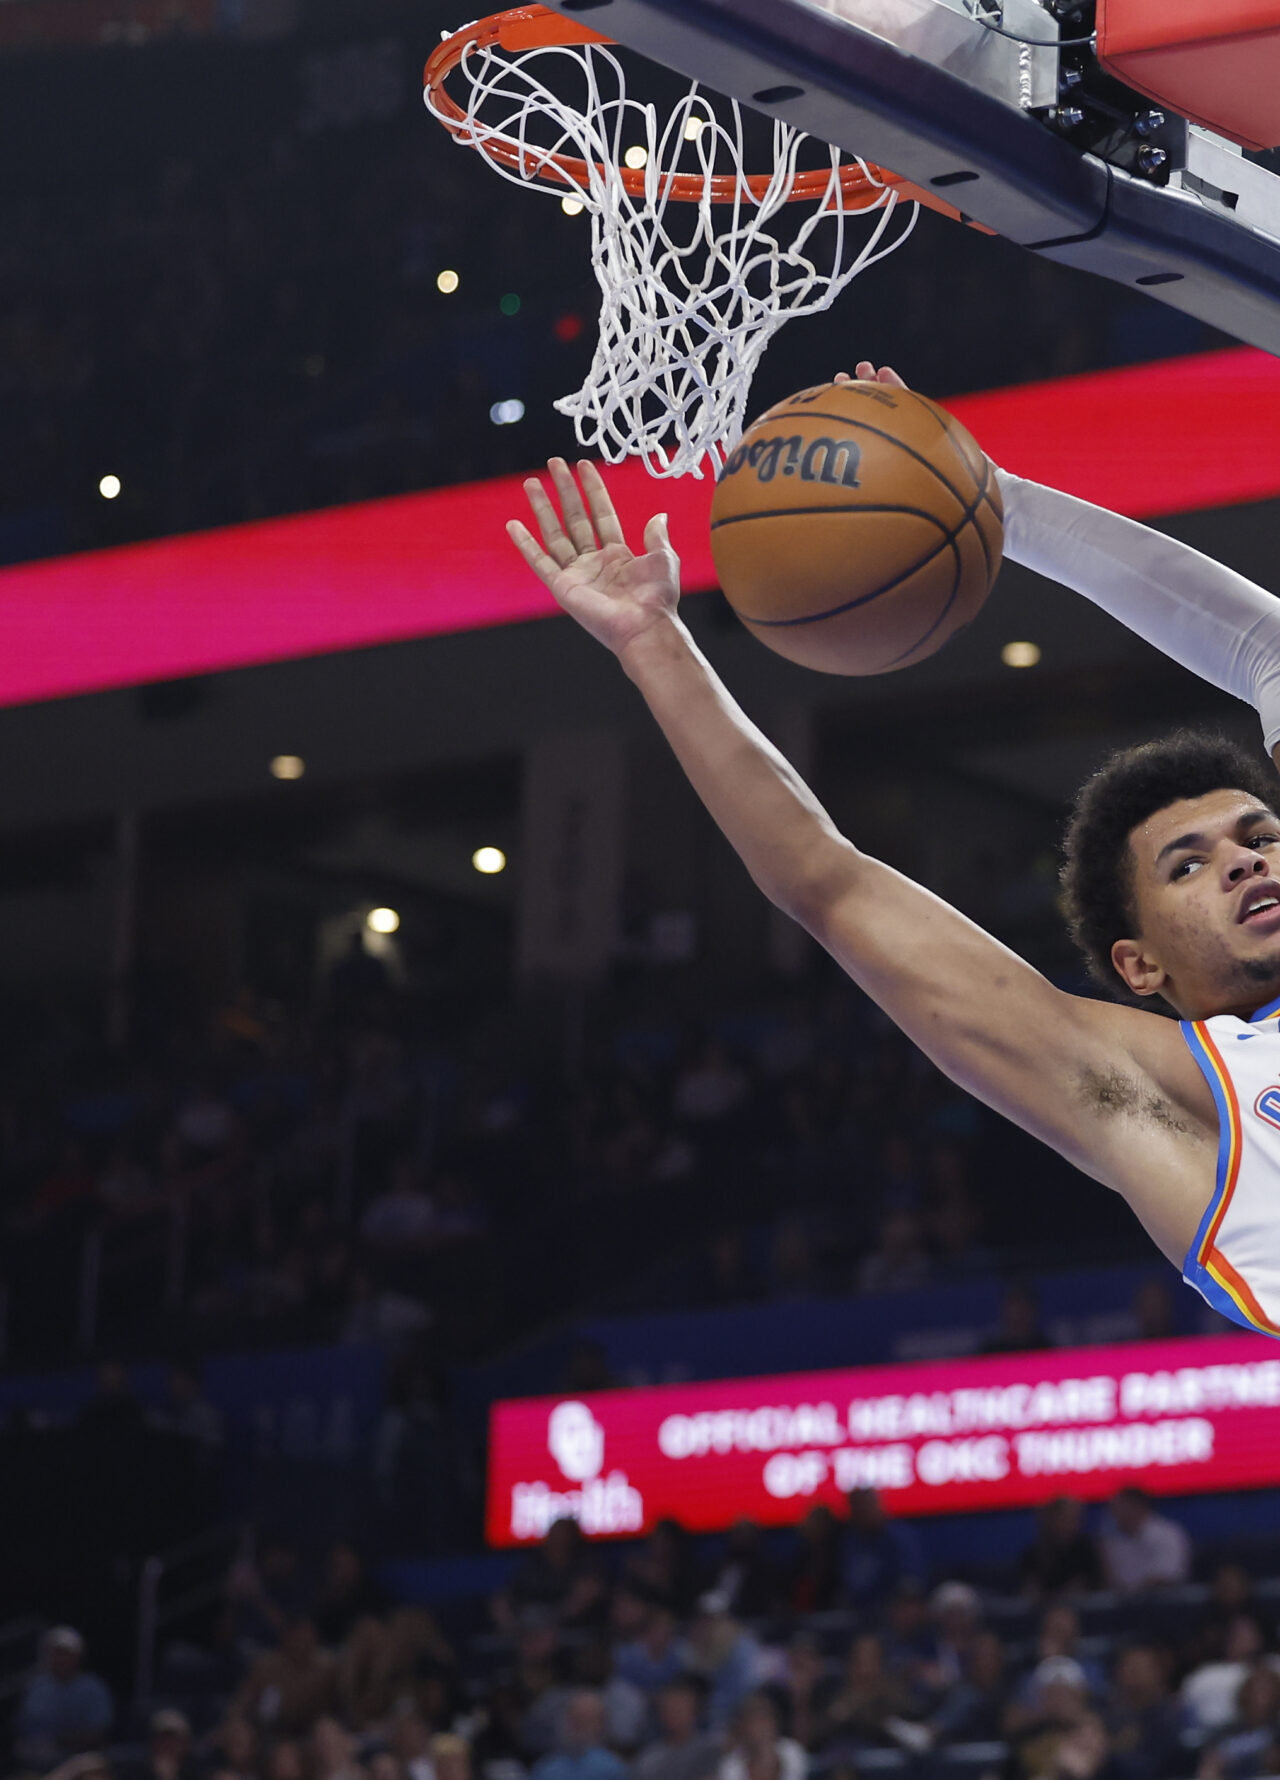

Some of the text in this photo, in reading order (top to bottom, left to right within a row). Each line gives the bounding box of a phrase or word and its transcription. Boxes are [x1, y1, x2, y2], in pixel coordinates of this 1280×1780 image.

[660, 1404, 844, 1457] OFFICIAL
[850, 1377, 1116, 1440] HEALTHCARE
[764, 1419, 1213, 1497] OF THE OKC THUNDER
